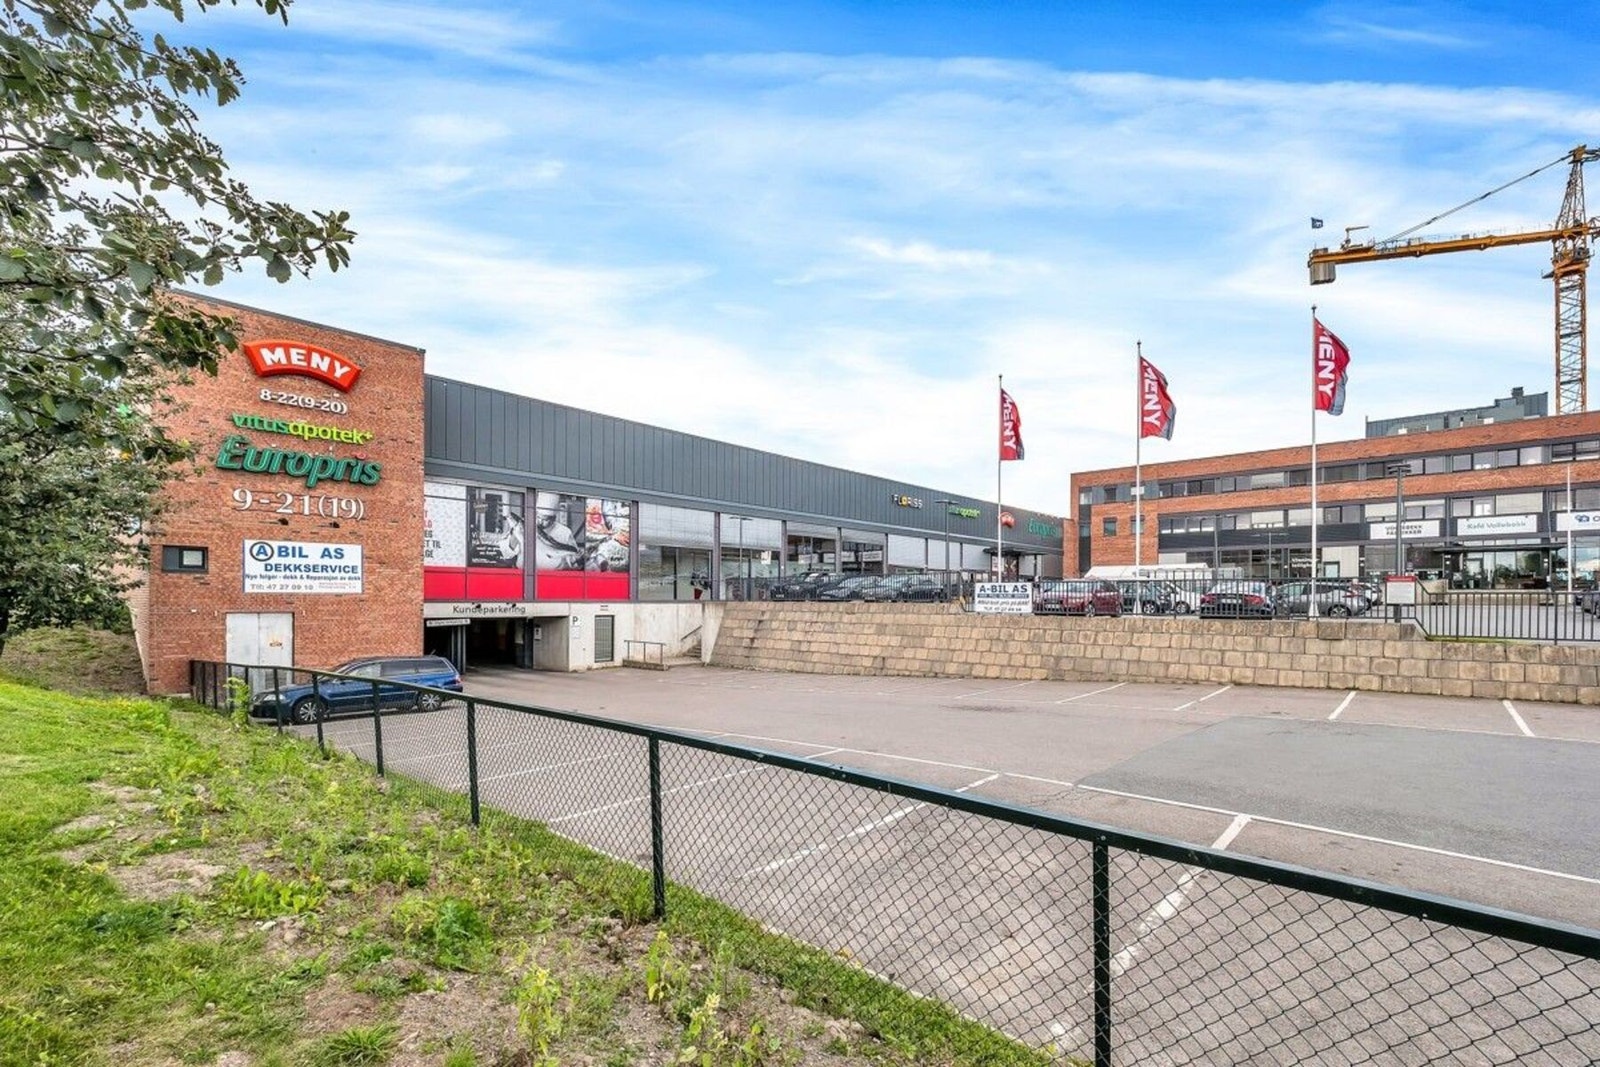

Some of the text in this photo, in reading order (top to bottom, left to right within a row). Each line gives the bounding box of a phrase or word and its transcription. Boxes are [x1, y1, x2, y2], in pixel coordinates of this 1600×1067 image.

[260, 347, 351, 378] MENY
[260, 388, 348, 414] 8-22(9-20)
[1142, 361, 1162, 428] MENY
[1003, 394, 1017, 449] MENY
[216, 434, 383, 488] Europris
[277, 545, 309, 558] BIL
[320, 547, 345, 560] AS
[264, 563, 359, 574] DEKKSERVICE
[979, 584, 1028, 593] A-BIL AS
